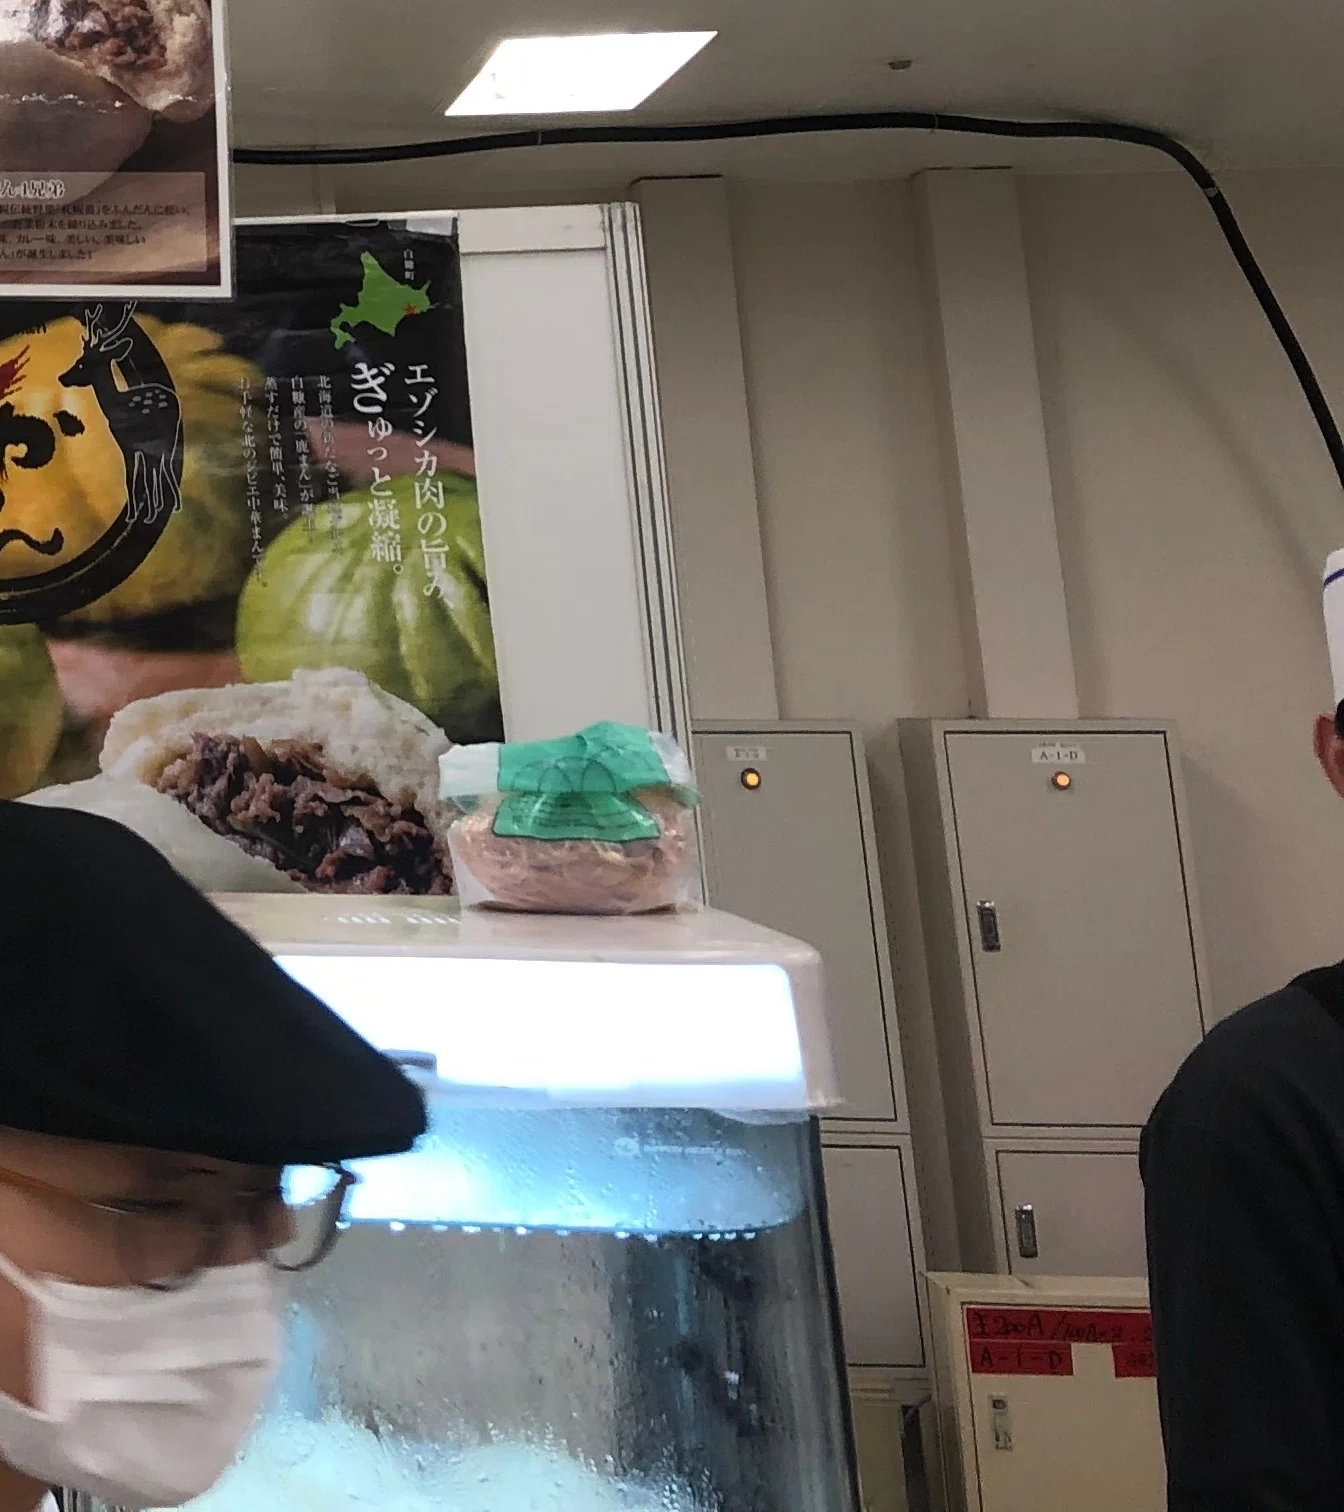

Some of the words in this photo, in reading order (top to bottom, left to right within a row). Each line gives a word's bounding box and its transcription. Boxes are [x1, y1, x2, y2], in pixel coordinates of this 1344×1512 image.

[350, 362, 404, 575] ぎゅっと凝縮。
